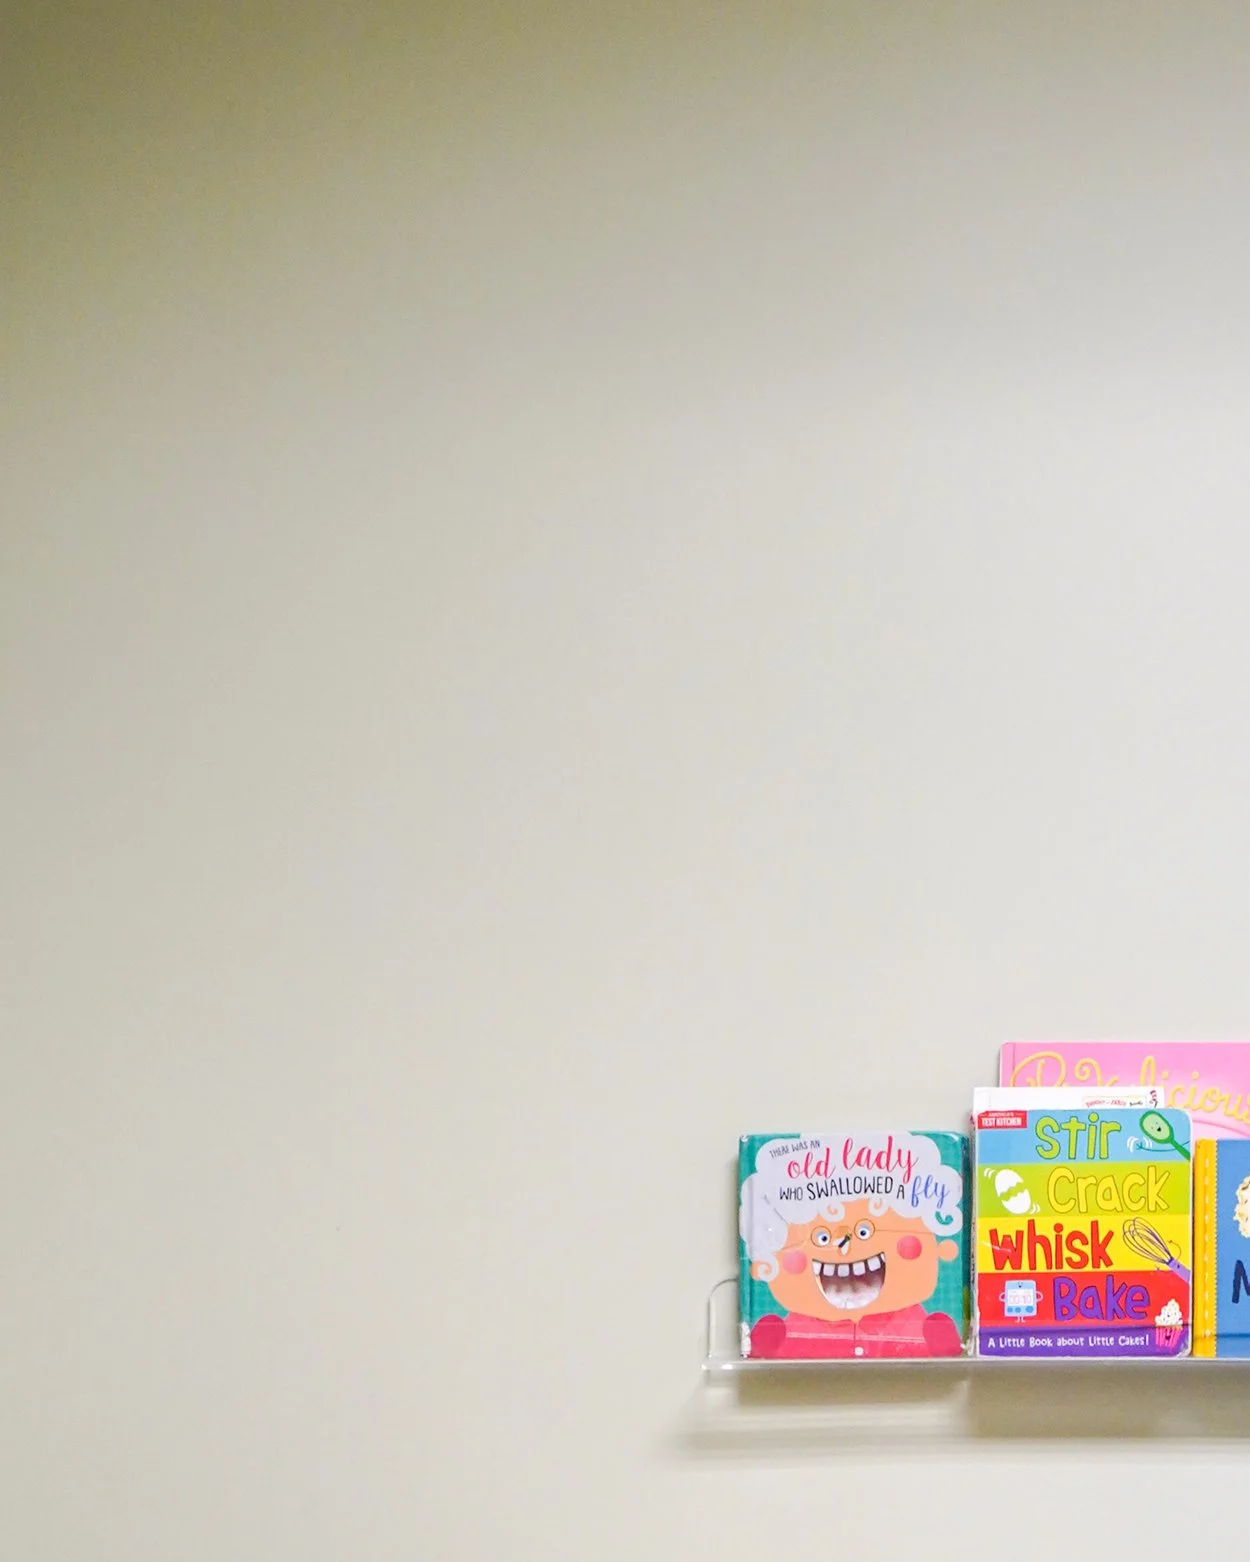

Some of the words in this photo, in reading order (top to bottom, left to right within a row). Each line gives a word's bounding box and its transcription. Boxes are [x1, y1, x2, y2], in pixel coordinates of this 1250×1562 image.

[982, 1117, 996, 1127] TEST
[996, 1116, 1022, 1126] KITCHEN
[1035, 1112, 1122, 1159] Stir
[769, 1145, 790, 1159] THERE
[791, 1142, 808, 1152] WAS
[809, 1140, 821, 1149] AN
[788, 1147, 836, 1179] old
[842, 1136, 919, 1184] lady
[779, 1186, 803, 1201] WHO
[806, 1176, 894, 1200] SWALLOWED
[896, 1184, 905, 1199] A
[911, 1174, 950, 1208] fly
[1047, 1165, 1170, 1213] Crack
[1053, 1274, 1150, 1321] Bake
[987, 1337, 996, 1348] A
[1029, 1336, 1053, 1348] Book
[1056, 1336, 1085, 1346] about
[1118, 1334, 1149, 1347] Cakes!
